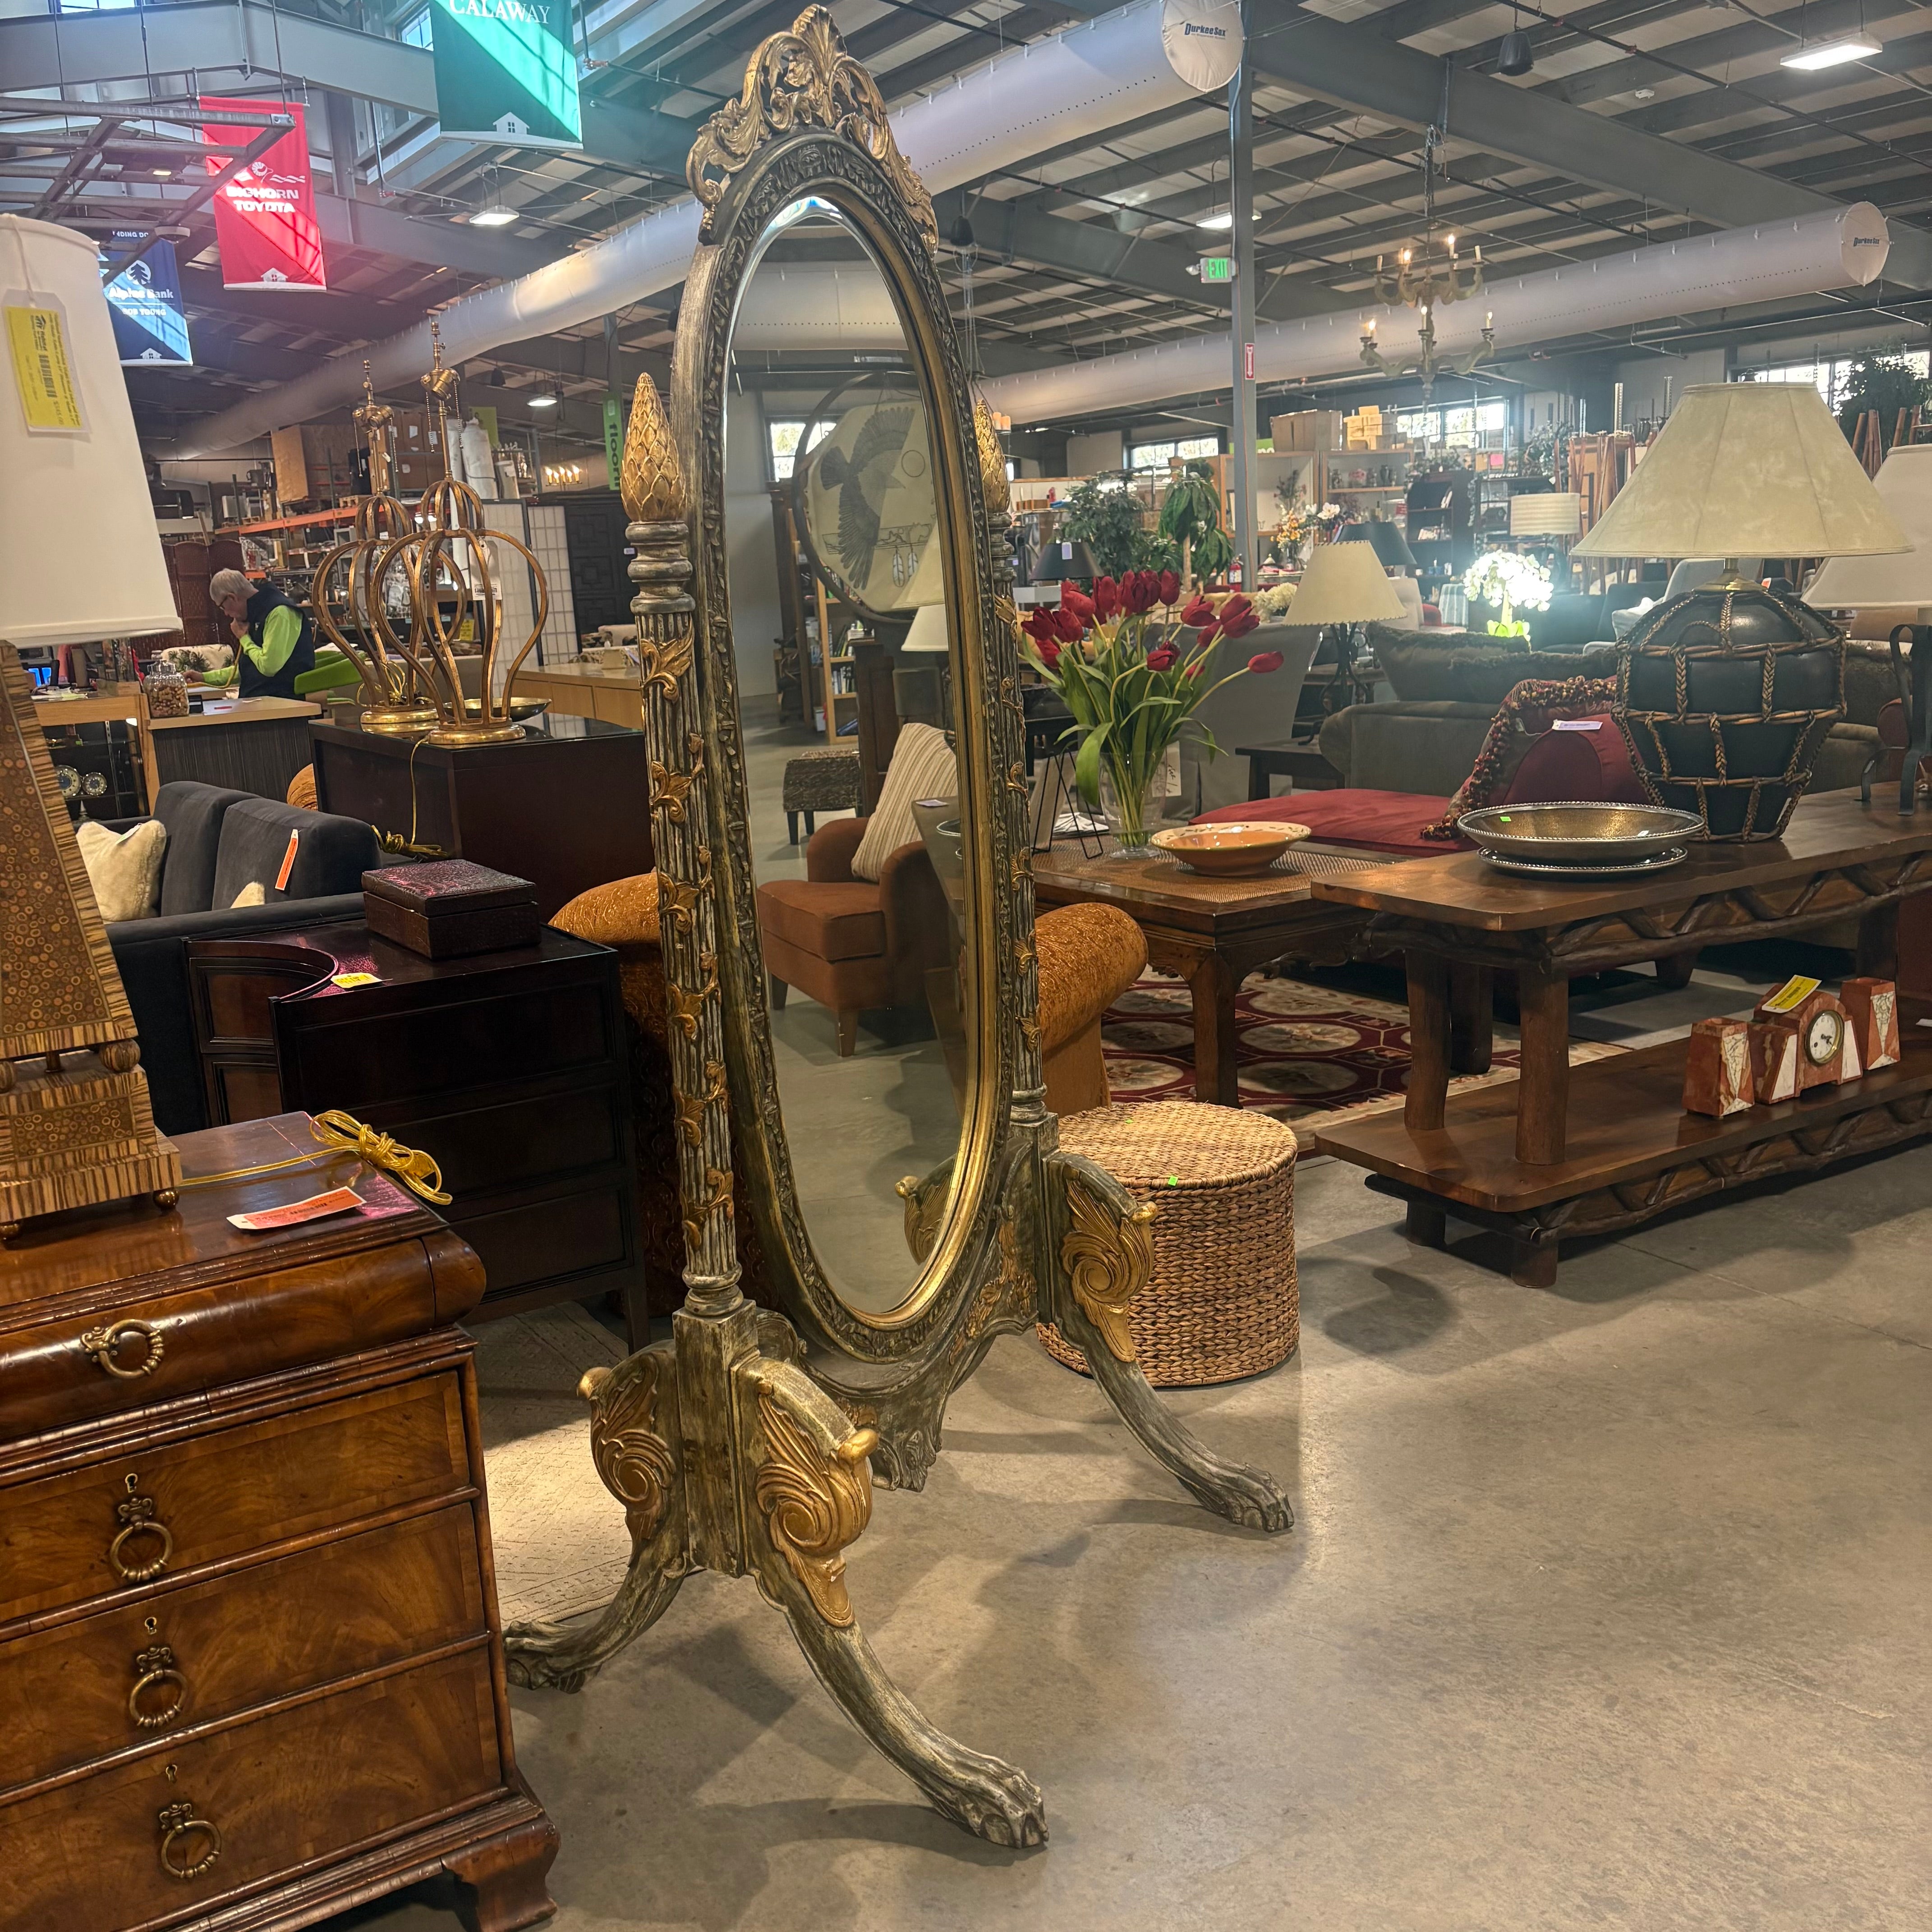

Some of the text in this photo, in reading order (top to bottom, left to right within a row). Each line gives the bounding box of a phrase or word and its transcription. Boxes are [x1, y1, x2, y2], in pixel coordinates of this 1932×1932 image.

[449, 0, 550, 24] CALAWAY
[226, 186, 299, 199] BIGHORN
[234, 200, 295, 212] TOYOTA
[1208, 258, 1228, 279] EXIT
[147, 289, 174, 298] Bank
